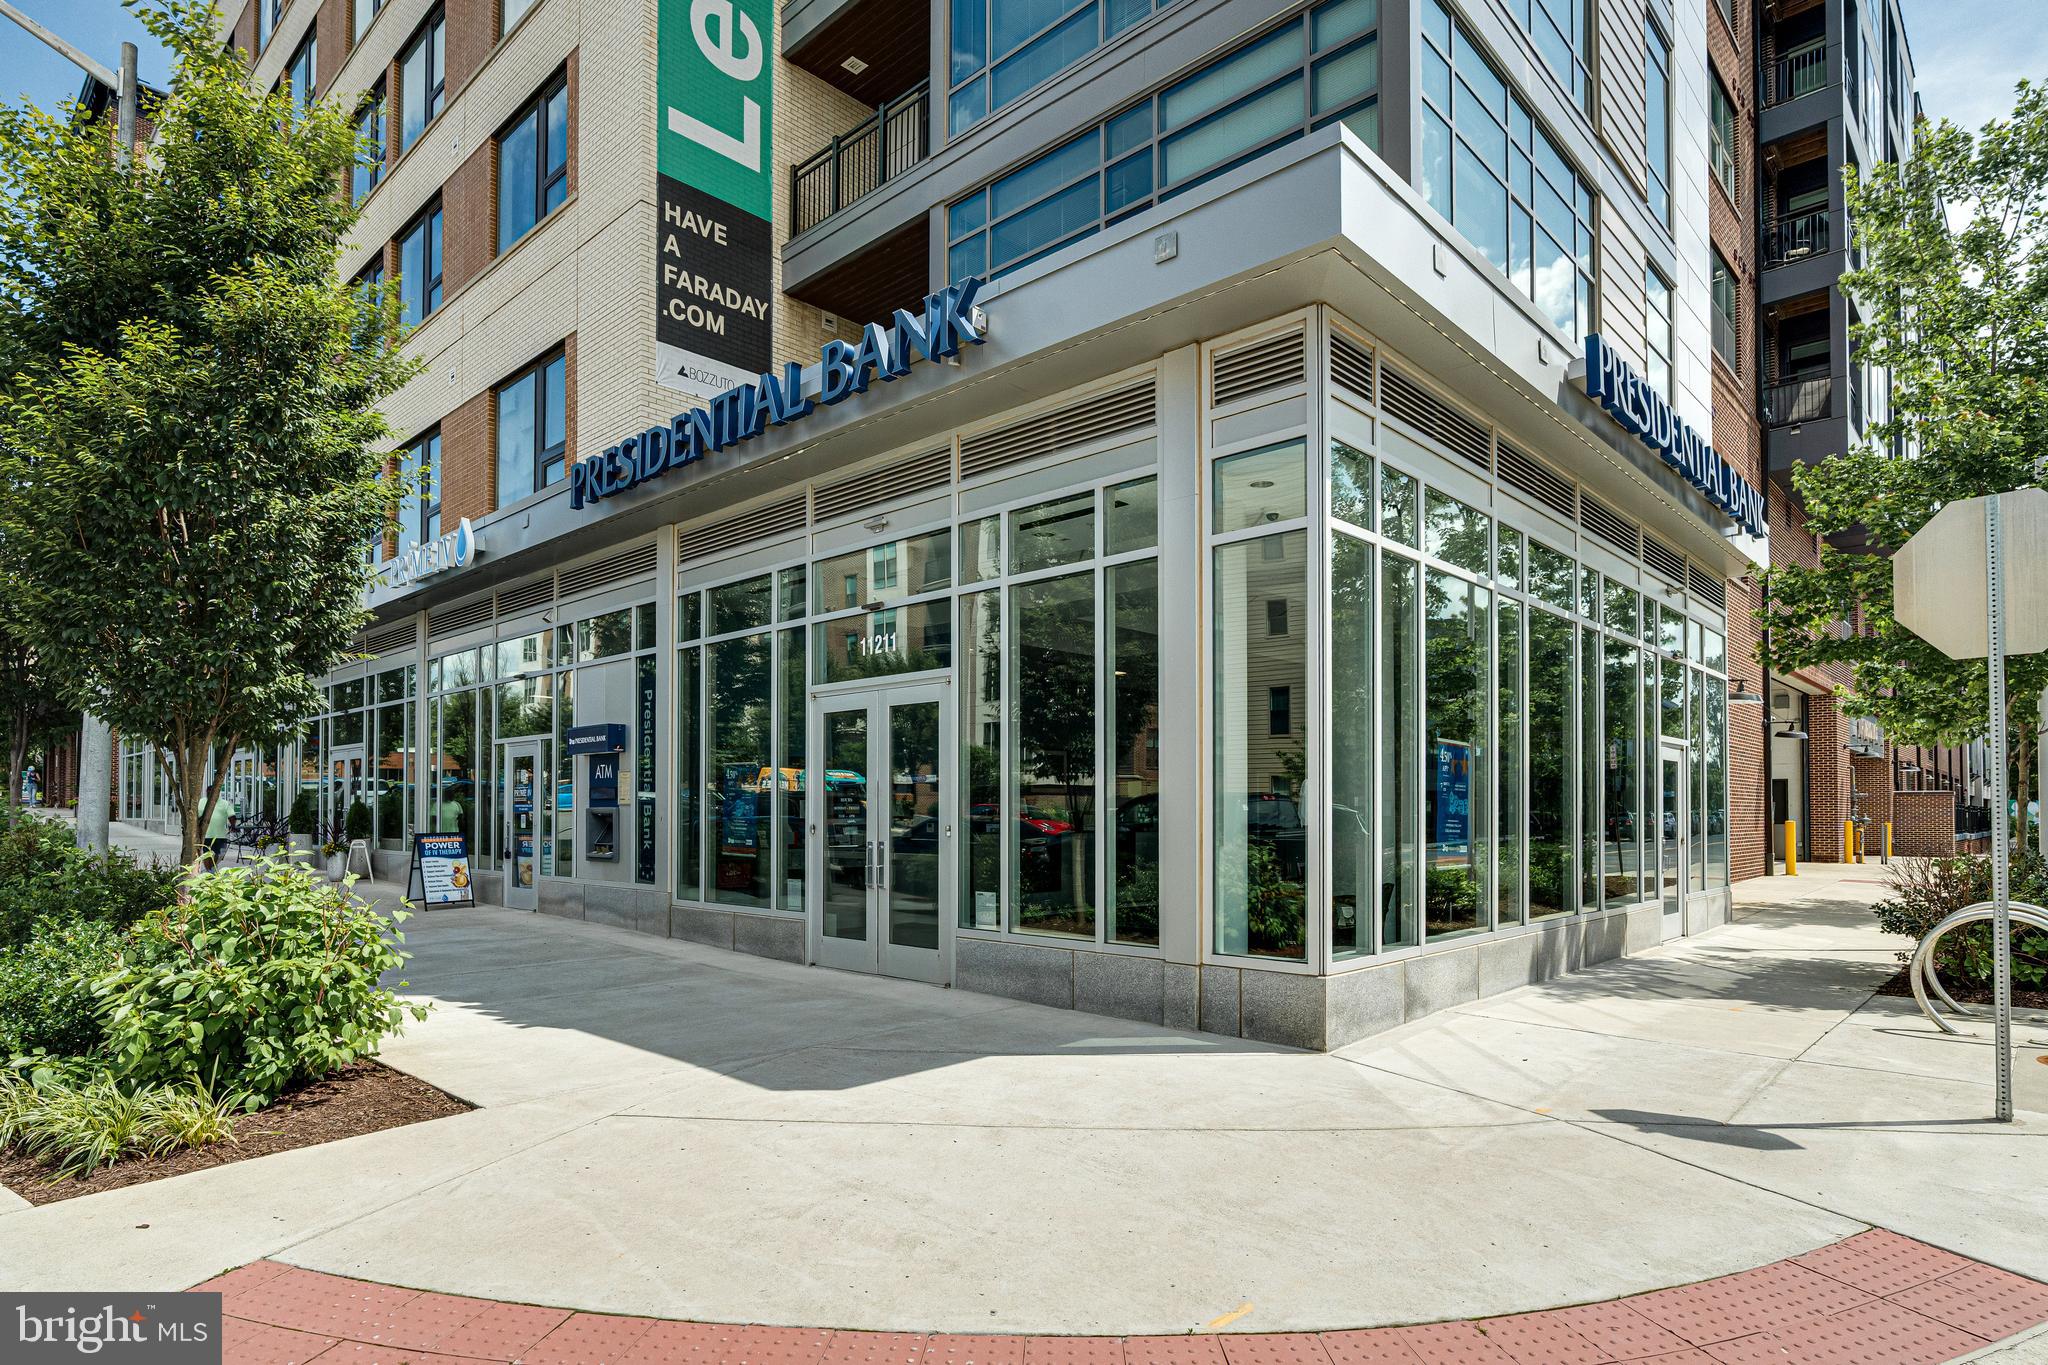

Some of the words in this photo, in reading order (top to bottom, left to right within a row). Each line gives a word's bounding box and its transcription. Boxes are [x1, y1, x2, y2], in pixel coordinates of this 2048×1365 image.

[664, 201, 728, 246] HAVE
[663, 233, 682, 258] A
[664, 263, 769, 321] FARADAY
[662, 298, 726, 336] .COM
[570, 362, 814, 510] PRESIDENTIAL
[821, 276, 986, 405] BANK
[689, 366, 735, 391] BOZZUTO
[1586, 333, 1728, 504] PRESIDENTIAL
[1728, 464, 1765, 536] BANK
[860, 632, 896, 656] 11211
[595, 764, 613, 779] ATM
[425, 841, 460, 850] POWER
[643, 804, 653, 850] Bank
